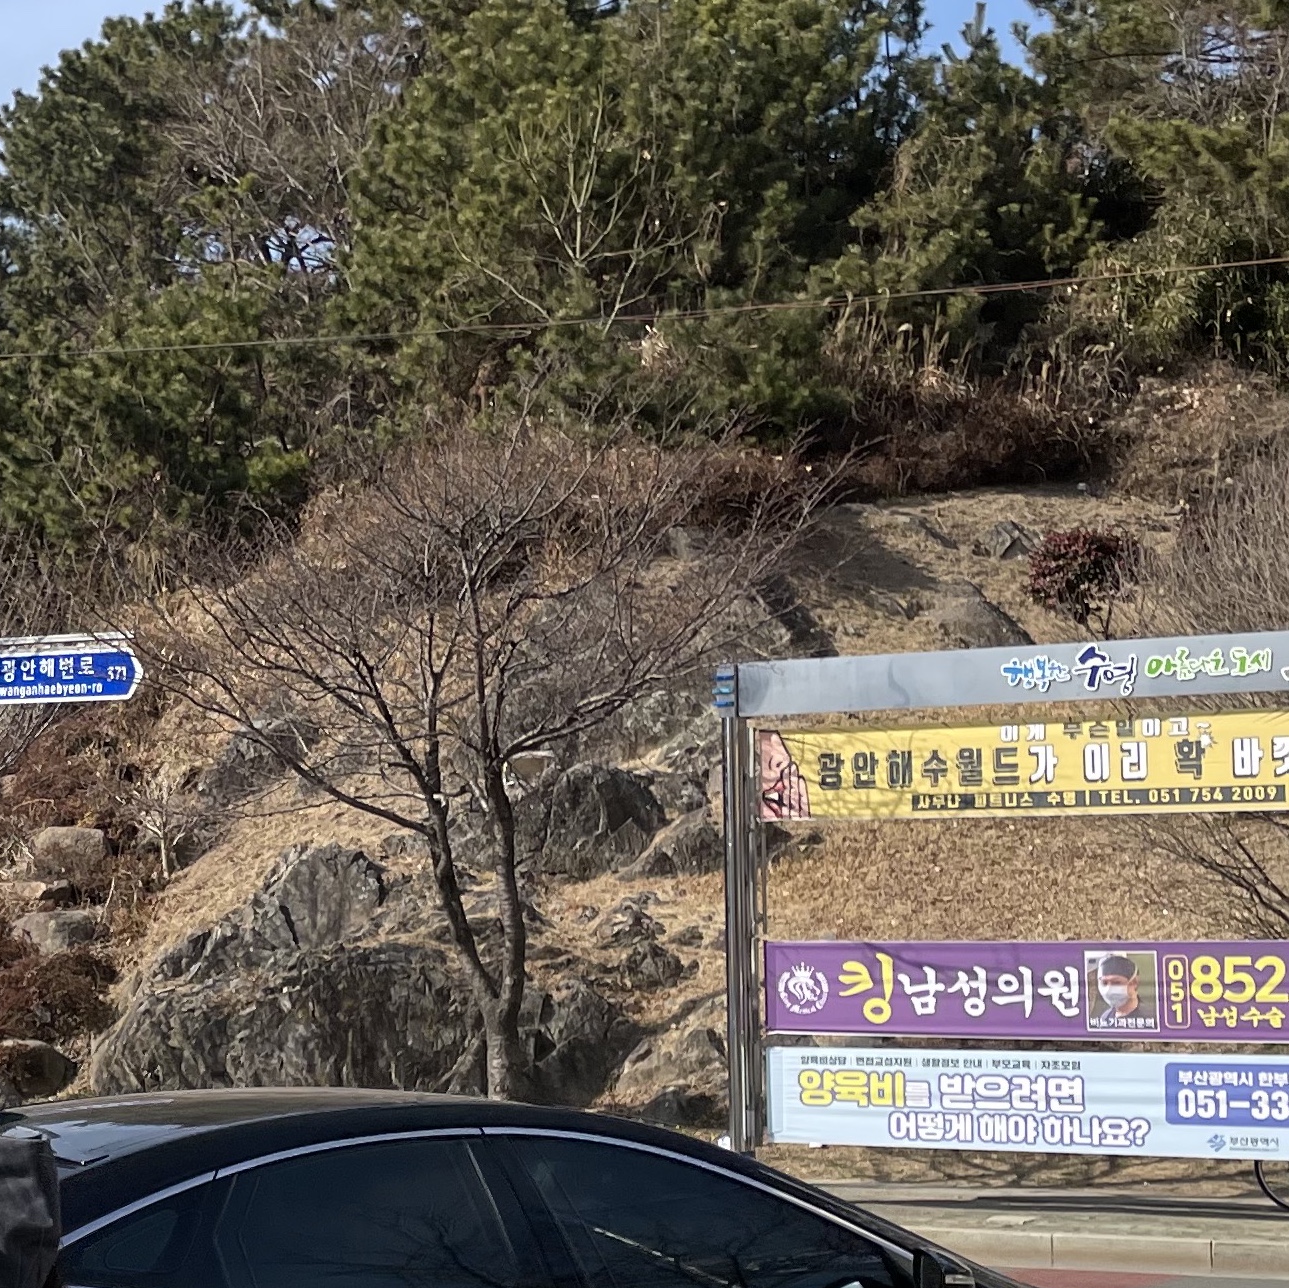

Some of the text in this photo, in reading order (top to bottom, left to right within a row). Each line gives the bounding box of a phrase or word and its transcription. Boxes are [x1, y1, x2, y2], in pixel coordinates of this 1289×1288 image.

[0, 655, 95, 682] 광안해변로
[106, 665, 127, 682] 371
[1001, 655, 1071, 692] 행복한
[1072, 643, 1138, 696] 수영
[1230, 646, 1272, 676] 도시
[1000, 722, 1046, 743] 이게
[1083, 741, 1148, 783] 이리
[1175, 738, 1206, 780] 확
[974, 791, 1034, 808] 피트니스
[1047, 791, 1076, 806] 수영
[1098, 789, 1141, 805] TEL.
[1149, 788, 1180, 803] 051
[1190, 786, 1224, 802] 754
[1231, 785, 1278, 801] 2009
[1168, 959, 1185, 1024] 051
[1190, 955, 1289, 1003] 852
[799, 1068, 1086, 1113] 양육비를 받으려면
[1178, 1069, 1254, 1087] 부산광역시
[1177, 1088, 1289, 1121] 051-33
[888, 1110, 1152, 1148] 어떻게 해야 하나요?
[1229, 1136, 1280, 1147] 부산광역시
